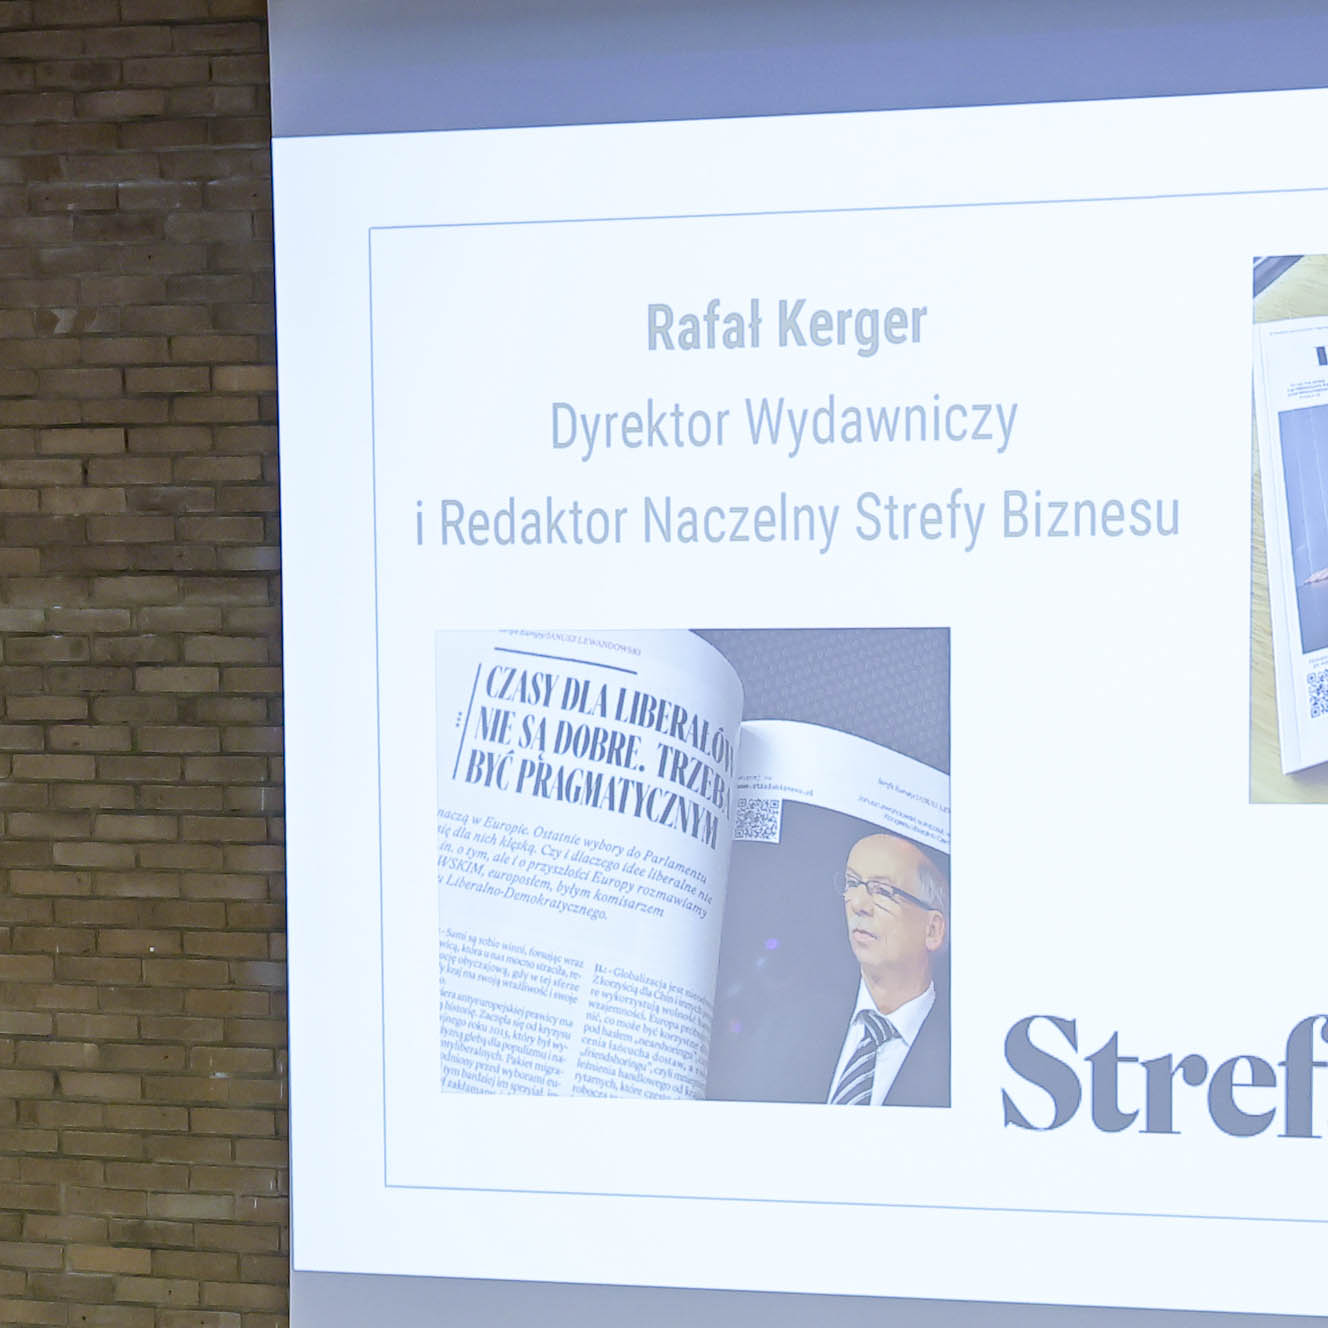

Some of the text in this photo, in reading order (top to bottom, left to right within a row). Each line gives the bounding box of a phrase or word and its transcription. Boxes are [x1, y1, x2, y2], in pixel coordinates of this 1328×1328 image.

[647, 299, 928, 358] Rafał Kerger
[551, 394, 1018, 462] Dyrektor Wydawniczy
[416, 488, 1180, 554] i Redaktor Naczelny Strefy Biznesu
[486, 664, 560, 708] CZASY
[561, 676, 610, 718] DLA
[474, 706, 516, 746] NIE
[519, 712, 549, 761] SĄ
[554, 720, 646, 772] DOBRE.
[465, 749, 720, 851] BYĆ PRAGMATYCZNYM
[453, 824, 470, 840] dla
[473, 831, 496, 846] nich
[540, 844, 561, 860] Czy
[571, 850, 620, 871] dlaczego
[622, 862, 644, 878] idee
[648, 867, 696, 895] liberalne
[484, 816, 530, 836] Europie.
[533, 825, 581, 846] Ostatnie
[583, 834, 624, 858] wybory
[628, 844, 641, 860] do
[643, 850, 708, 884] Parlamentu
[446, 873, 608, 920] Liberalno-Demokratycznego.
[488, 868, 553, 893] europosłem,
[556, 880, 597, 902] byłym
[593, 888, 664, 918] komisarzem
[493, 852, 508, 865] ale
[524, 858, 590, 882] przyszłości
[592, 872, 634, 893] Europy
[637, 884, 708, 919] rozmawiamy
